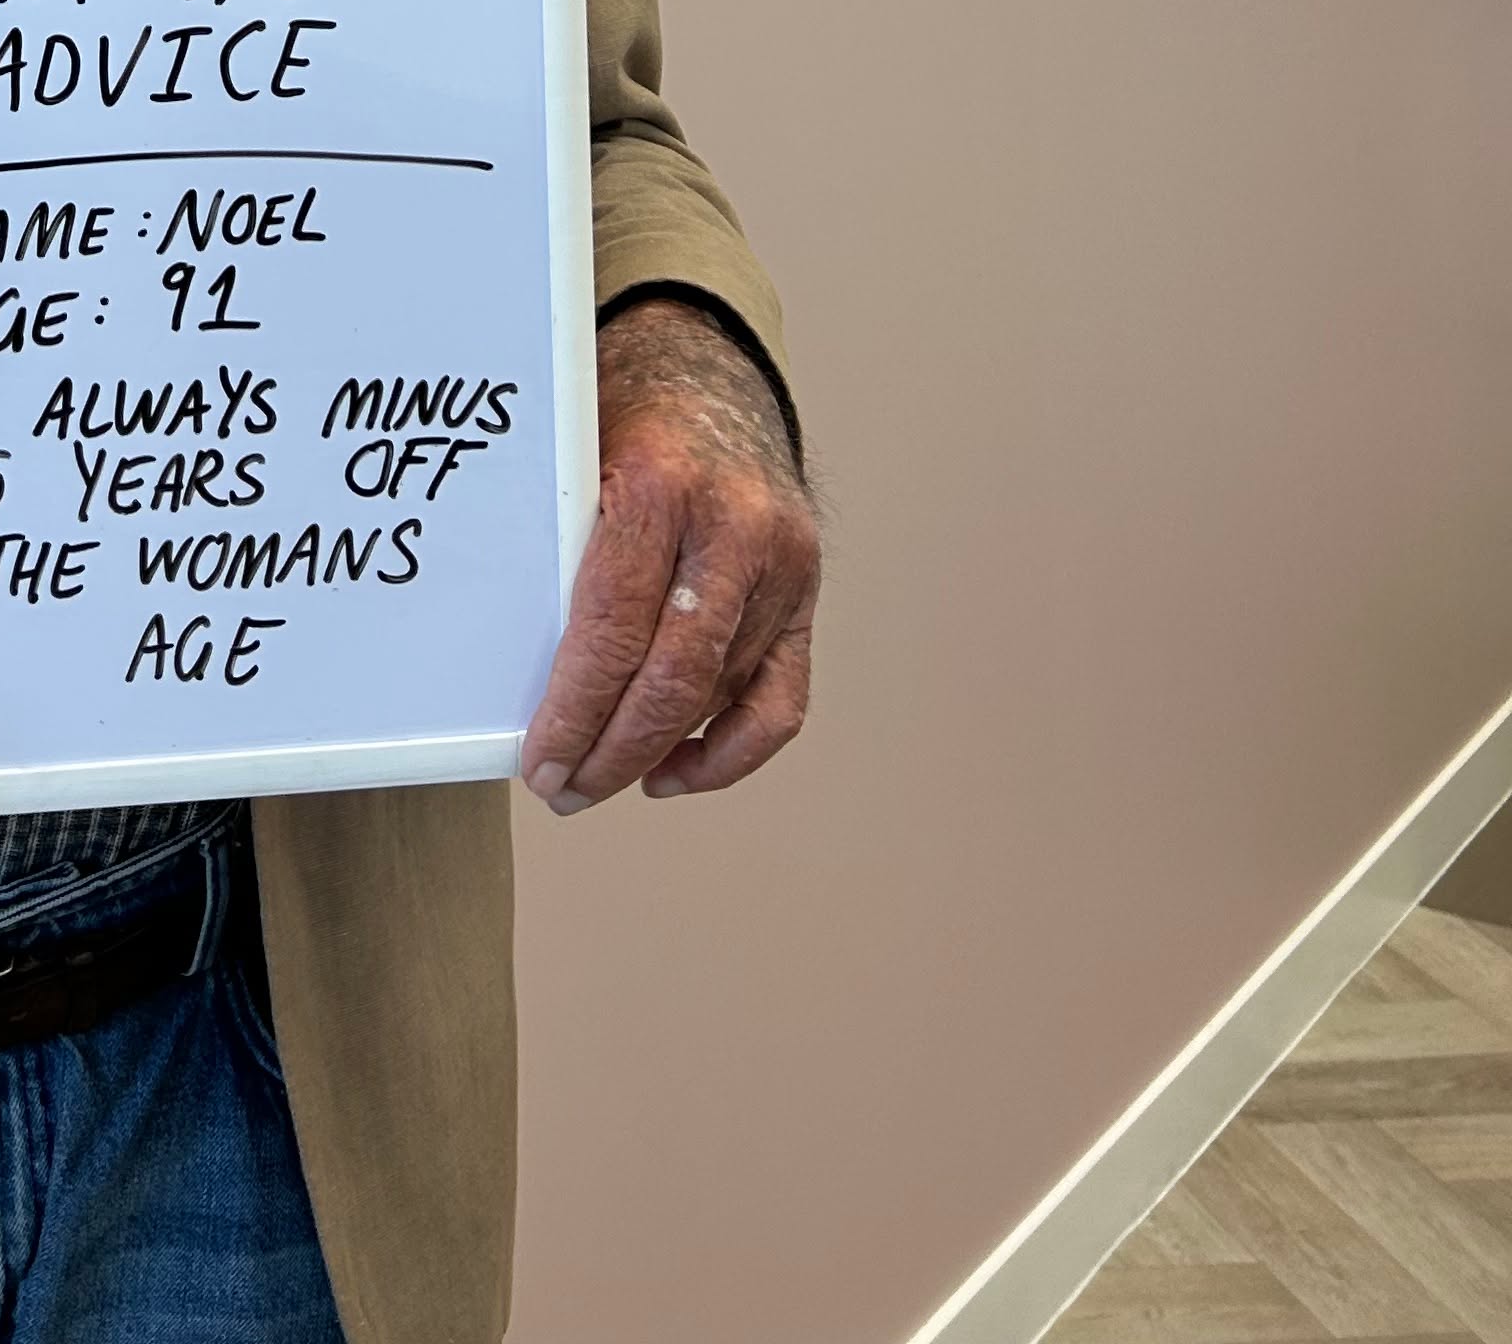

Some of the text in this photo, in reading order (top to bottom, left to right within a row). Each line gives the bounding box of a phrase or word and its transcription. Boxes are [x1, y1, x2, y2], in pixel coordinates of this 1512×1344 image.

[161, 261, 261, 333] 91
[32, 365, 278, 441] ALWAYS
[321, 374, 518, 435] MINUS
[72, 439, 266, 523] YEARS
[344, 436, 489, 502] OFF
[139, 518, 423, 592] WOMANS
[124, 613, 287, 686] AGE
